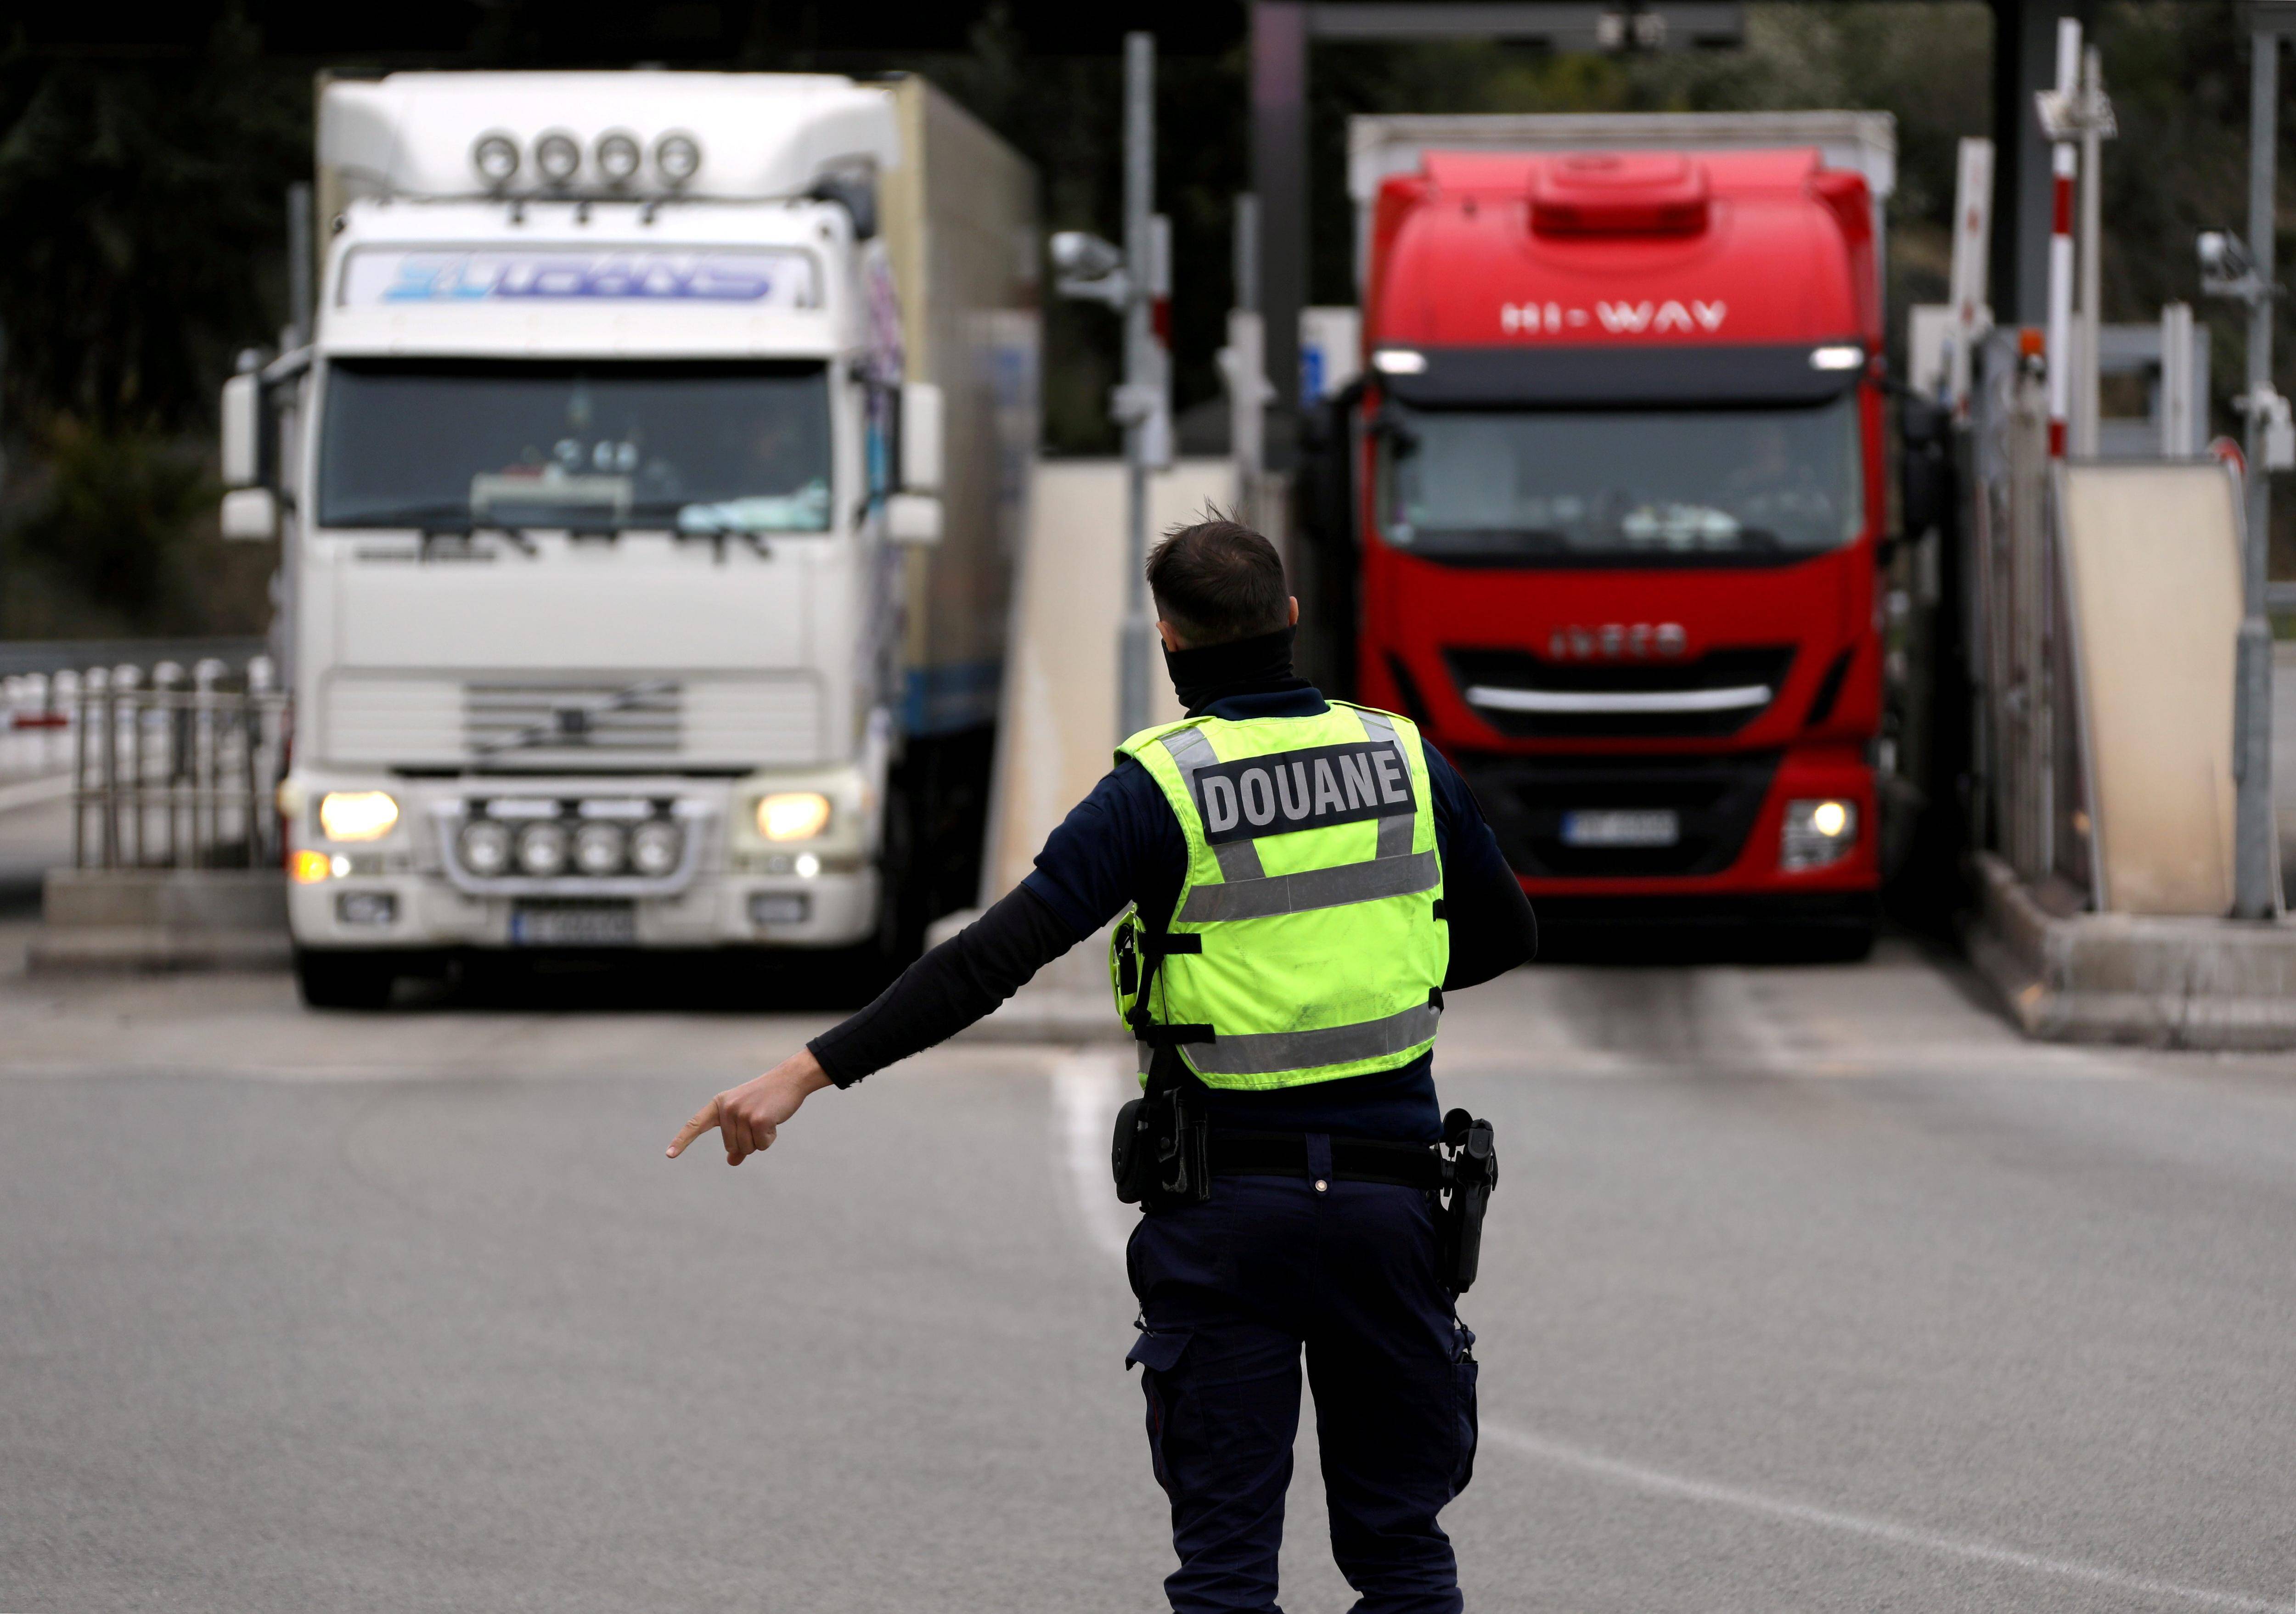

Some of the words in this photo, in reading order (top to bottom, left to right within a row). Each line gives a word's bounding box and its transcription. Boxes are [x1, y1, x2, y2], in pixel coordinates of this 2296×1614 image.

[1500, 300, 1728, 335] HI-WAY
[1549, 622, 1688, 659] IVECO
[1202, 750, 1408, 833] DOUANE
